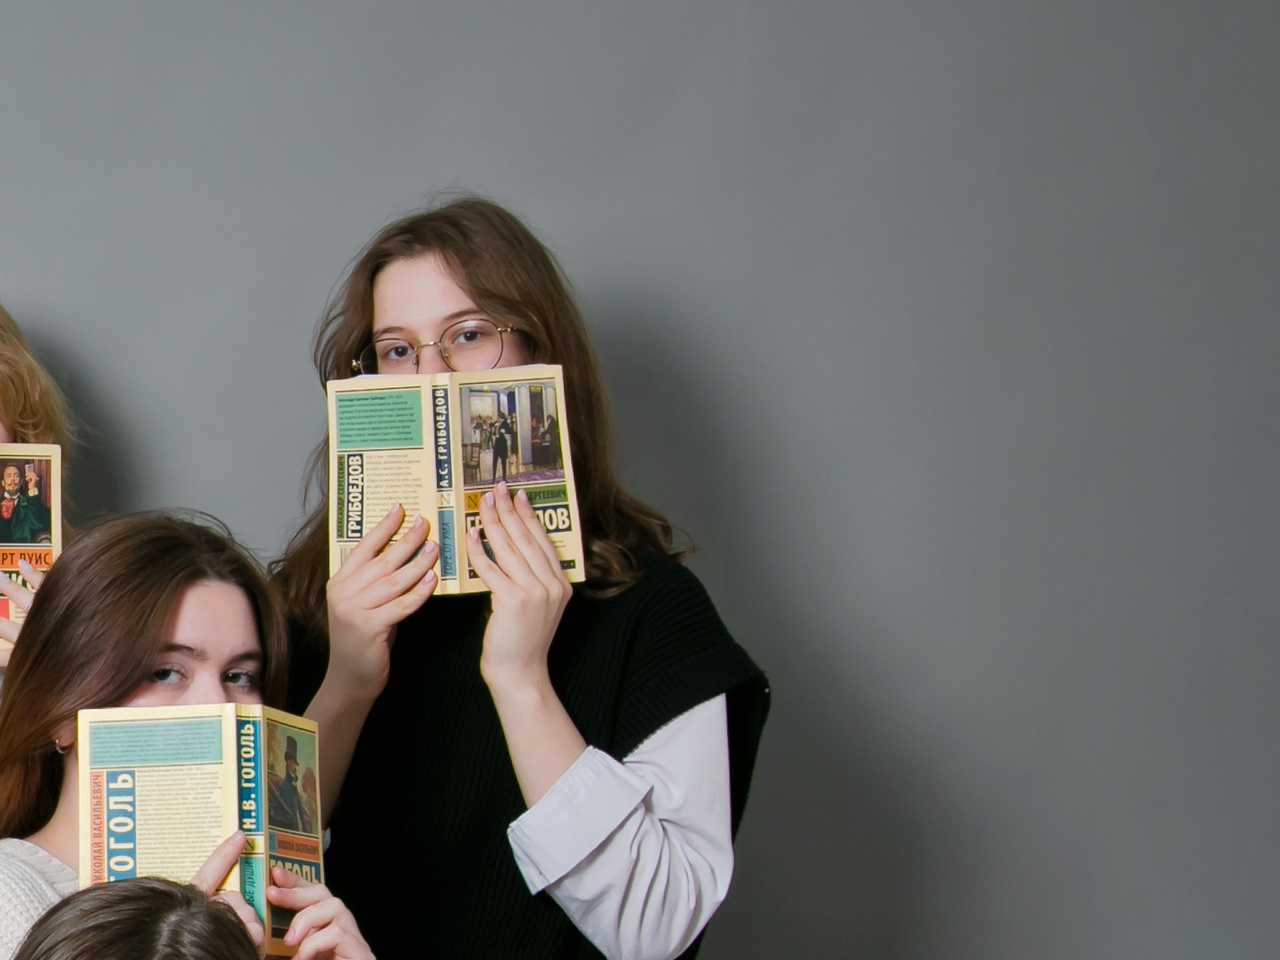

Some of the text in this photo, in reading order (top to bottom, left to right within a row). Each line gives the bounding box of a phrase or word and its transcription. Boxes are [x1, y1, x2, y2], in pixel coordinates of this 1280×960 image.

[435, 389, 449, 487] А.С. ГРИБОЕДОВ
[348, 456, 364, 538] ГРИБОЕДОВ
[92, 774, 103, 839] ВАСИЛЬЕВИЧ
[240, 723, 257, 829] Н.В. ГОГОЛЬ
[108, 773, 135, 882] ОГОЛЬ
